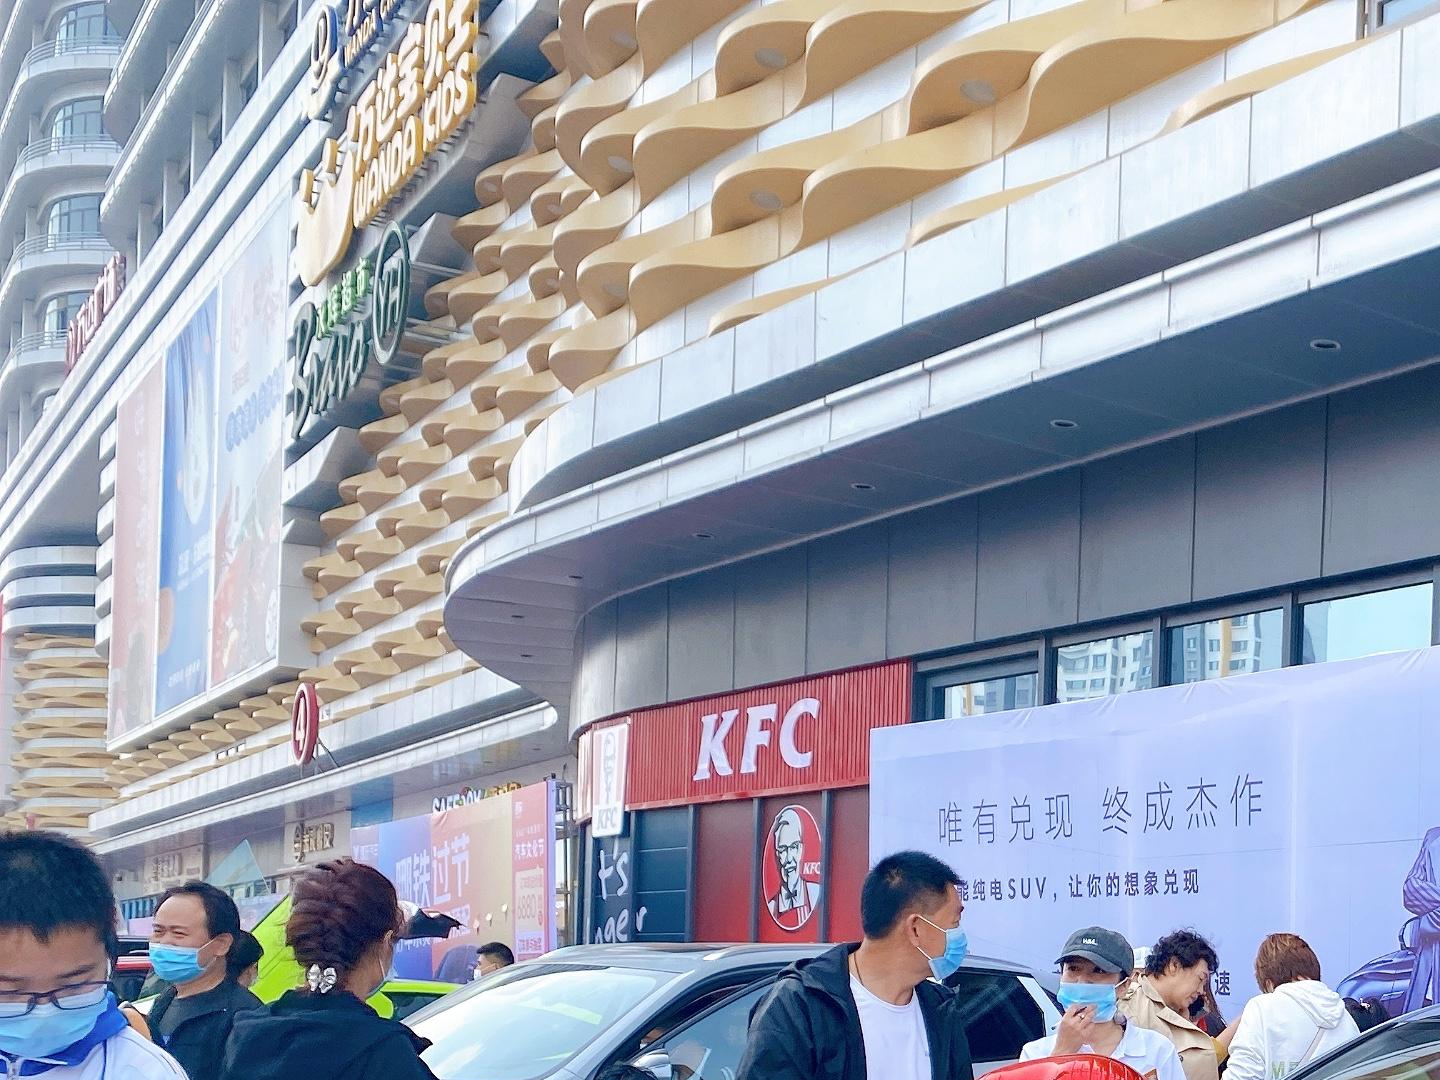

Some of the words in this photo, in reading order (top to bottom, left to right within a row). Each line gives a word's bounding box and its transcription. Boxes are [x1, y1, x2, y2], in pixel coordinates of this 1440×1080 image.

[353, 115, 421, 228] WANDA
[423, 52, 476, 152] KIDS
[295, 696, 306, 752] 4
[693, 698, 821, 781] KFC
[597, 807, 617, 831] KFC
[937, 793, 1073, 847] 唯有兑现
[1102, 773, 1263, 835] 终成杰作
[803, 862, 821, 875] KFC
[1214, 970, 1231, 996] 速
